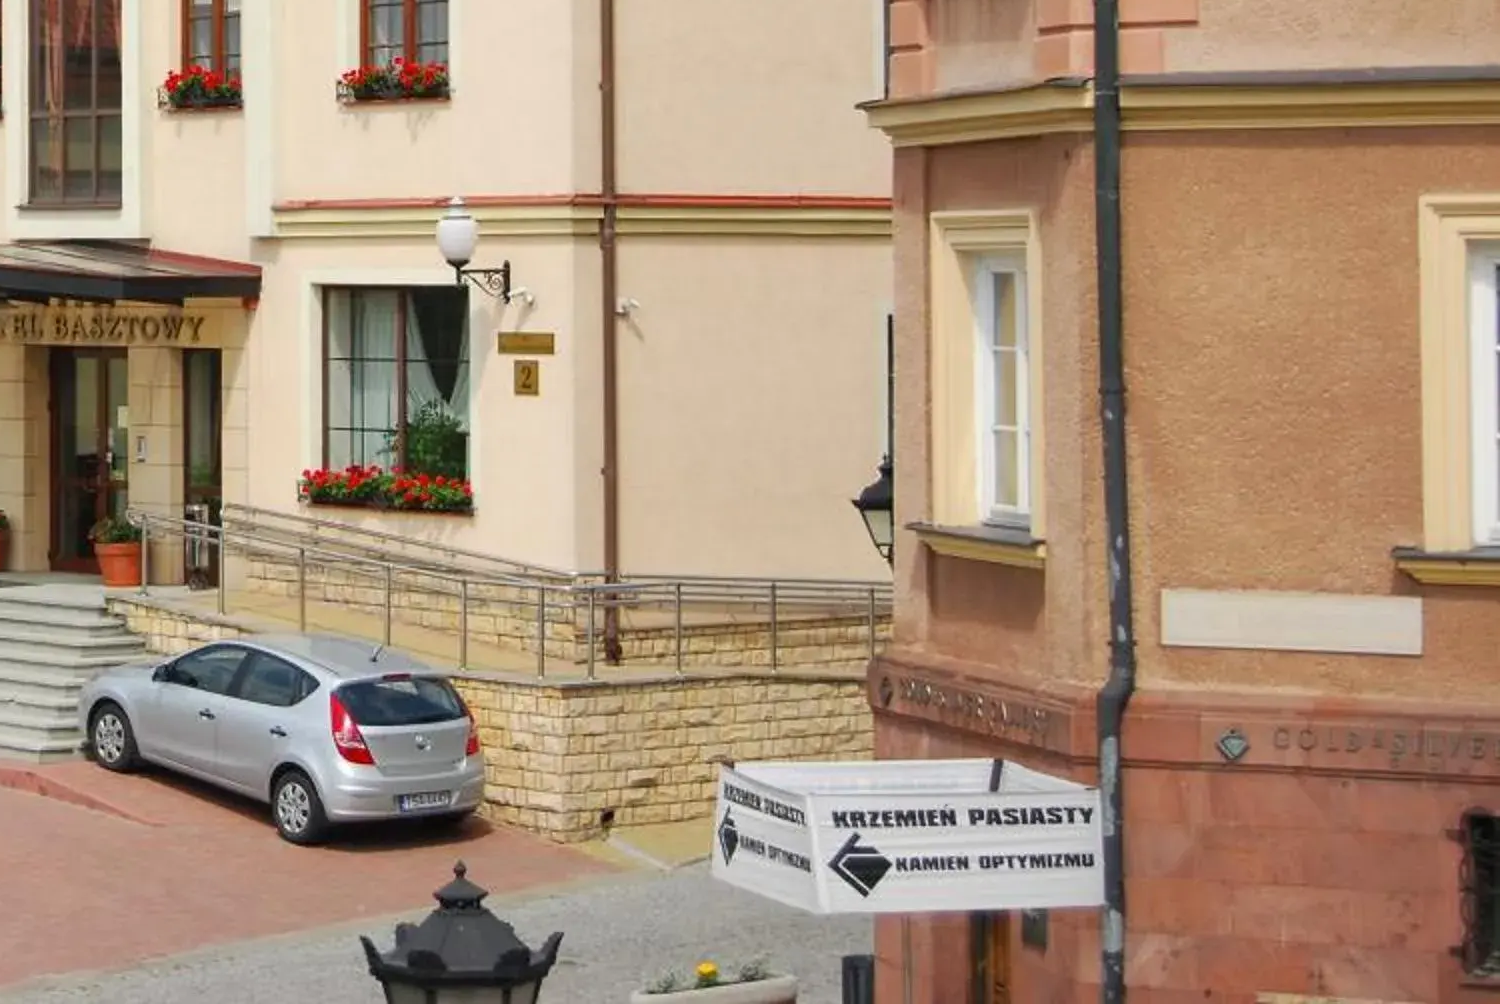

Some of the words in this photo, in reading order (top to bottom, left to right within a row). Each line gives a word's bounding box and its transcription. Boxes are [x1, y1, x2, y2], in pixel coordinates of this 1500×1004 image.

[54, 314, 204, 341] BASZTOWY
[521, 365, 533, 389] 2
[968, 807, 1093, 825] PASIASTY
[979, 854, 1094, 869] OPTYMIZMU
